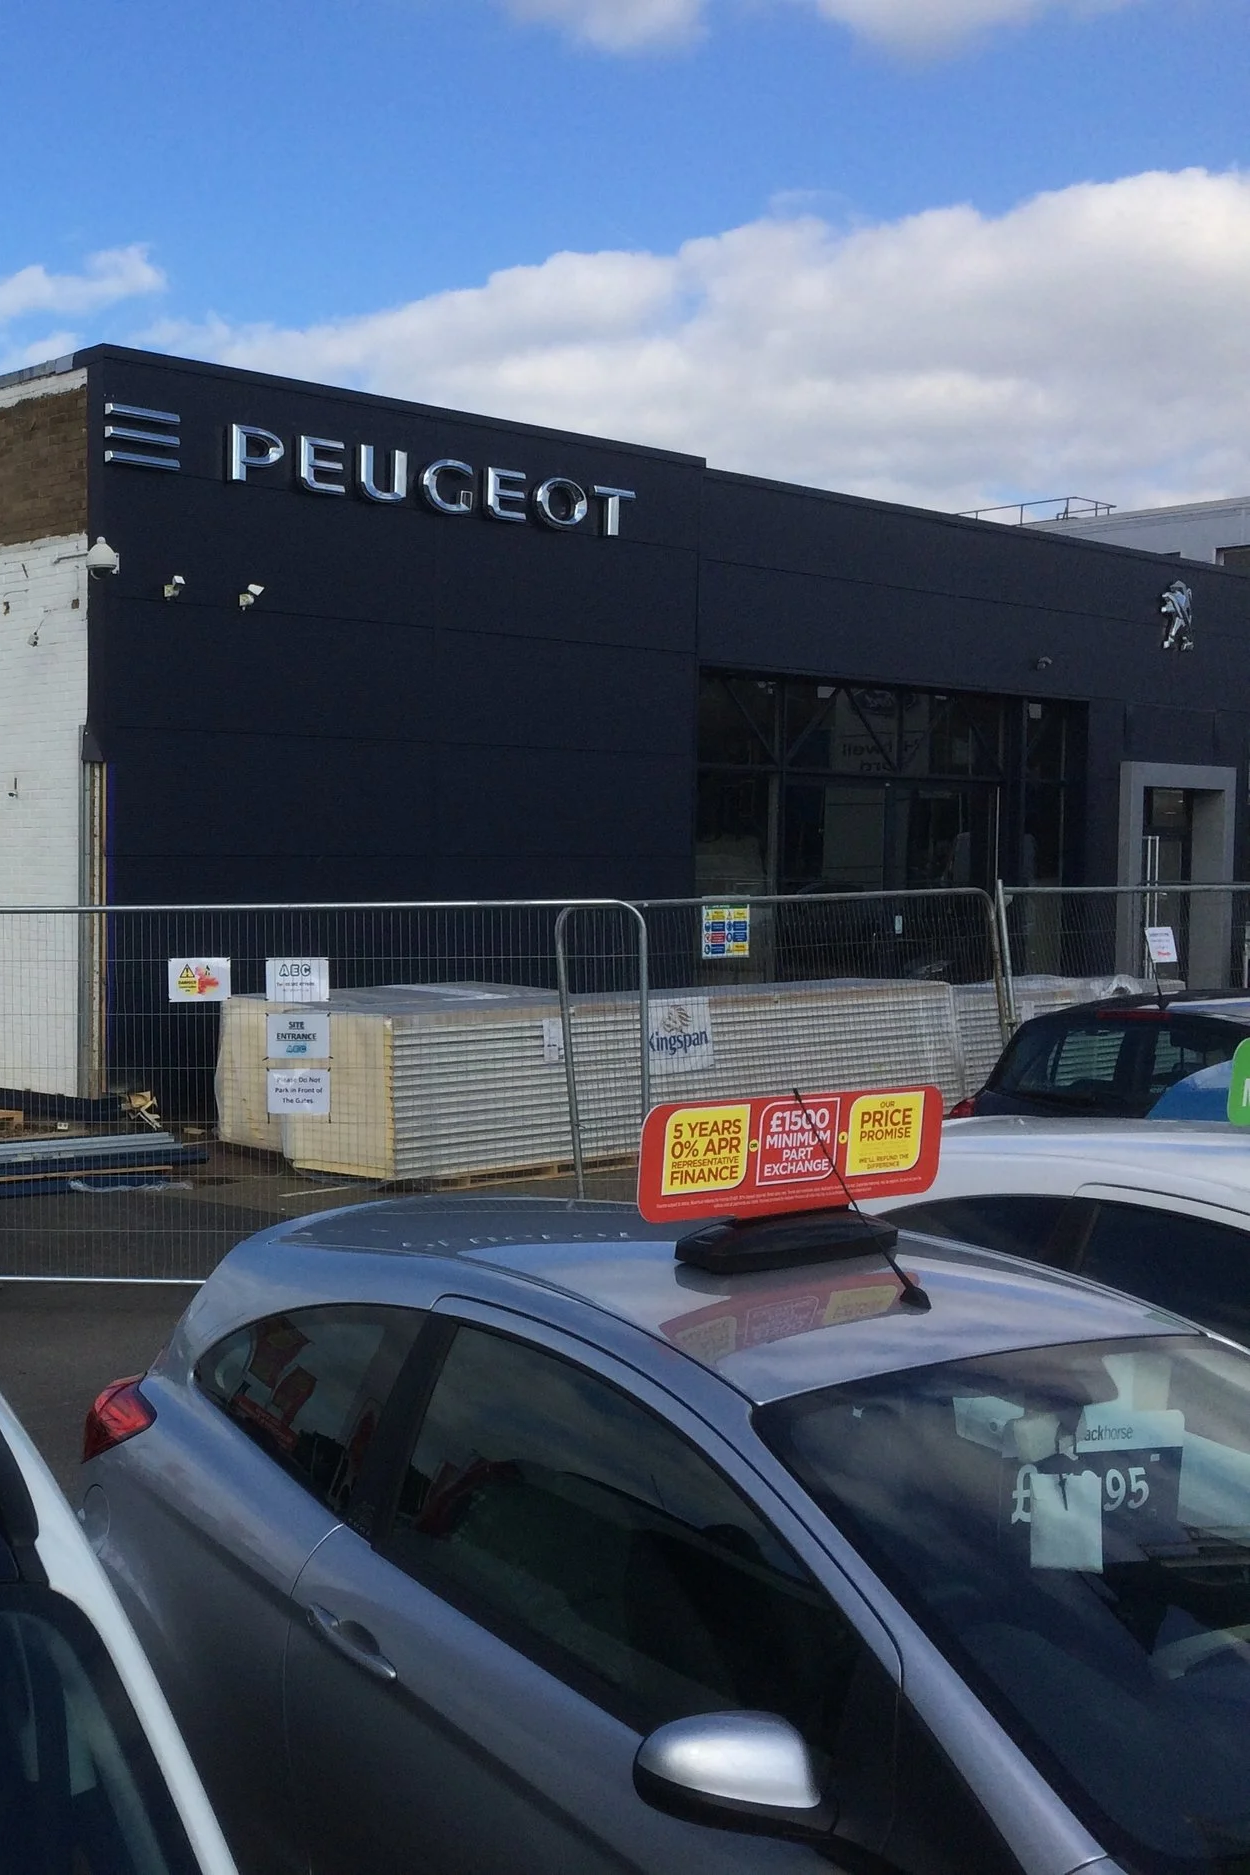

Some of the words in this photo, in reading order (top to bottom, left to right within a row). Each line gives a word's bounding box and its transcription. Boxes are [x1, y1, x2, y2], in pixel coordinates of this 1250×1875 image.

[230, 422, 637, 537] PEUGEOT
[279, 963, 311, 977] AEC
[288, 1021, 305, 1030] SITE
[276, 1032, 317, 1041] ENTRANCE
[880, 1100, 895, 1109] OUR
[770, 1108, 830, 1133] £1500
[860, 1107, 913, 1130] PRICE
[673, 1123, 683, 1140] 5
[687, 1119, 742, 1139] YEARS
[859, 1127, 912, 1142] PROMISE
[671, 1140, 699, 1159] 0%
[703, 1137, 741, 1157] APR
[766, 1130, 831, 1149] MINIMUM
[671, 1156, 739, 1169] REPRESENTATIVE
[782, 1147, 814, 1161] PART
[670, 1165, 739, 1186] FINANCE
[764, 1158, 829, 1177] EXCHANGE
[1084, 1424, 1134, 1442] ackhorse
[1011, 1463, 1150, 1525] £95
